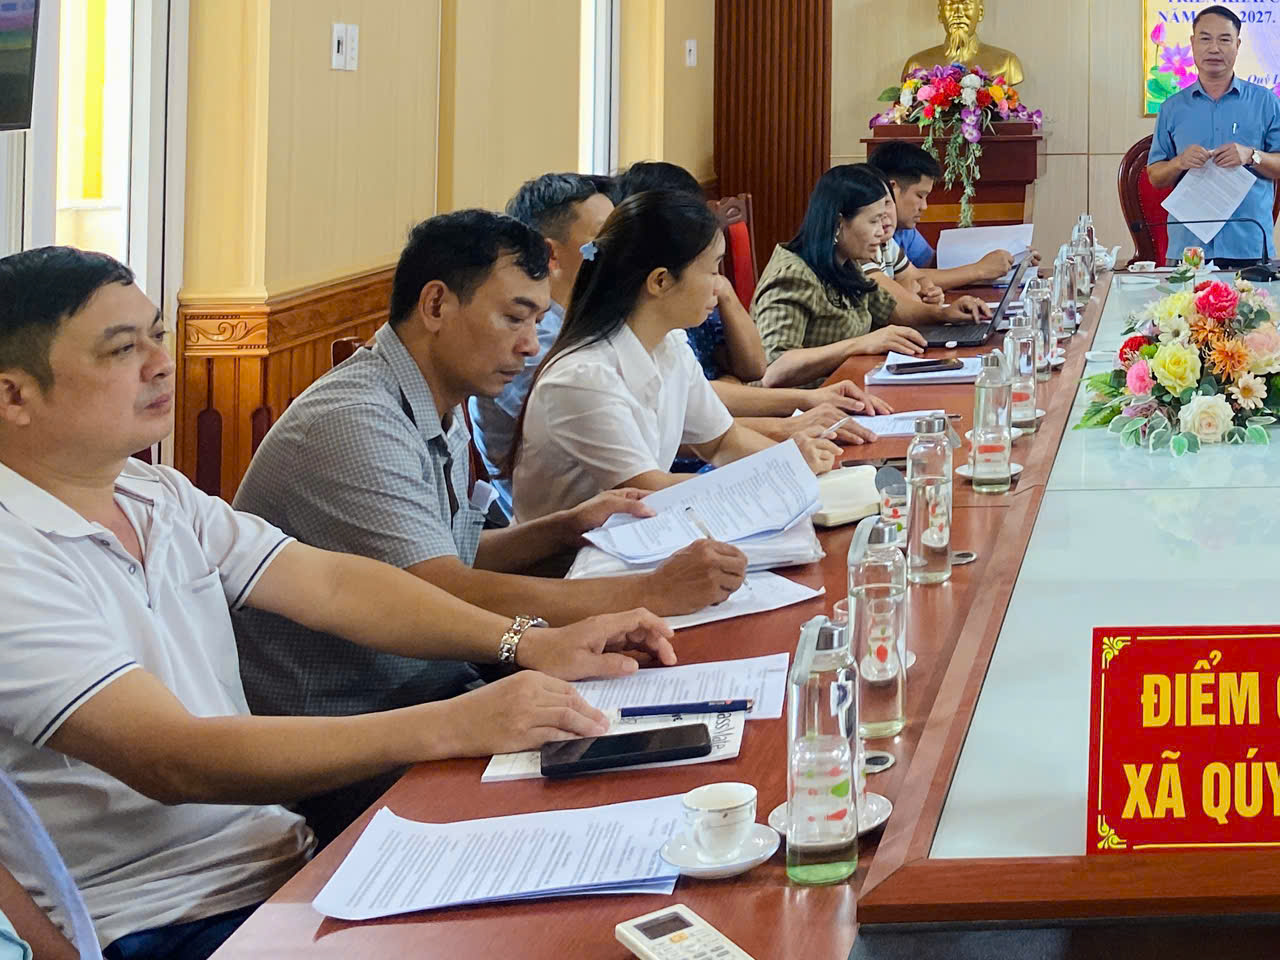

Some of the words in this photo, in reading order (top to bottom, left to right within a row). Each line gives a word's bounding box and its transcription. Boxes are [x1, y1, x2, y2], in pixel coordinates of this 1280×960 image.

[1159, 7, 1196, 23] NĂM
[1140, 649, 1261, 728] ĐIỂM
[1120, 750, 1187, 820] XÃ
